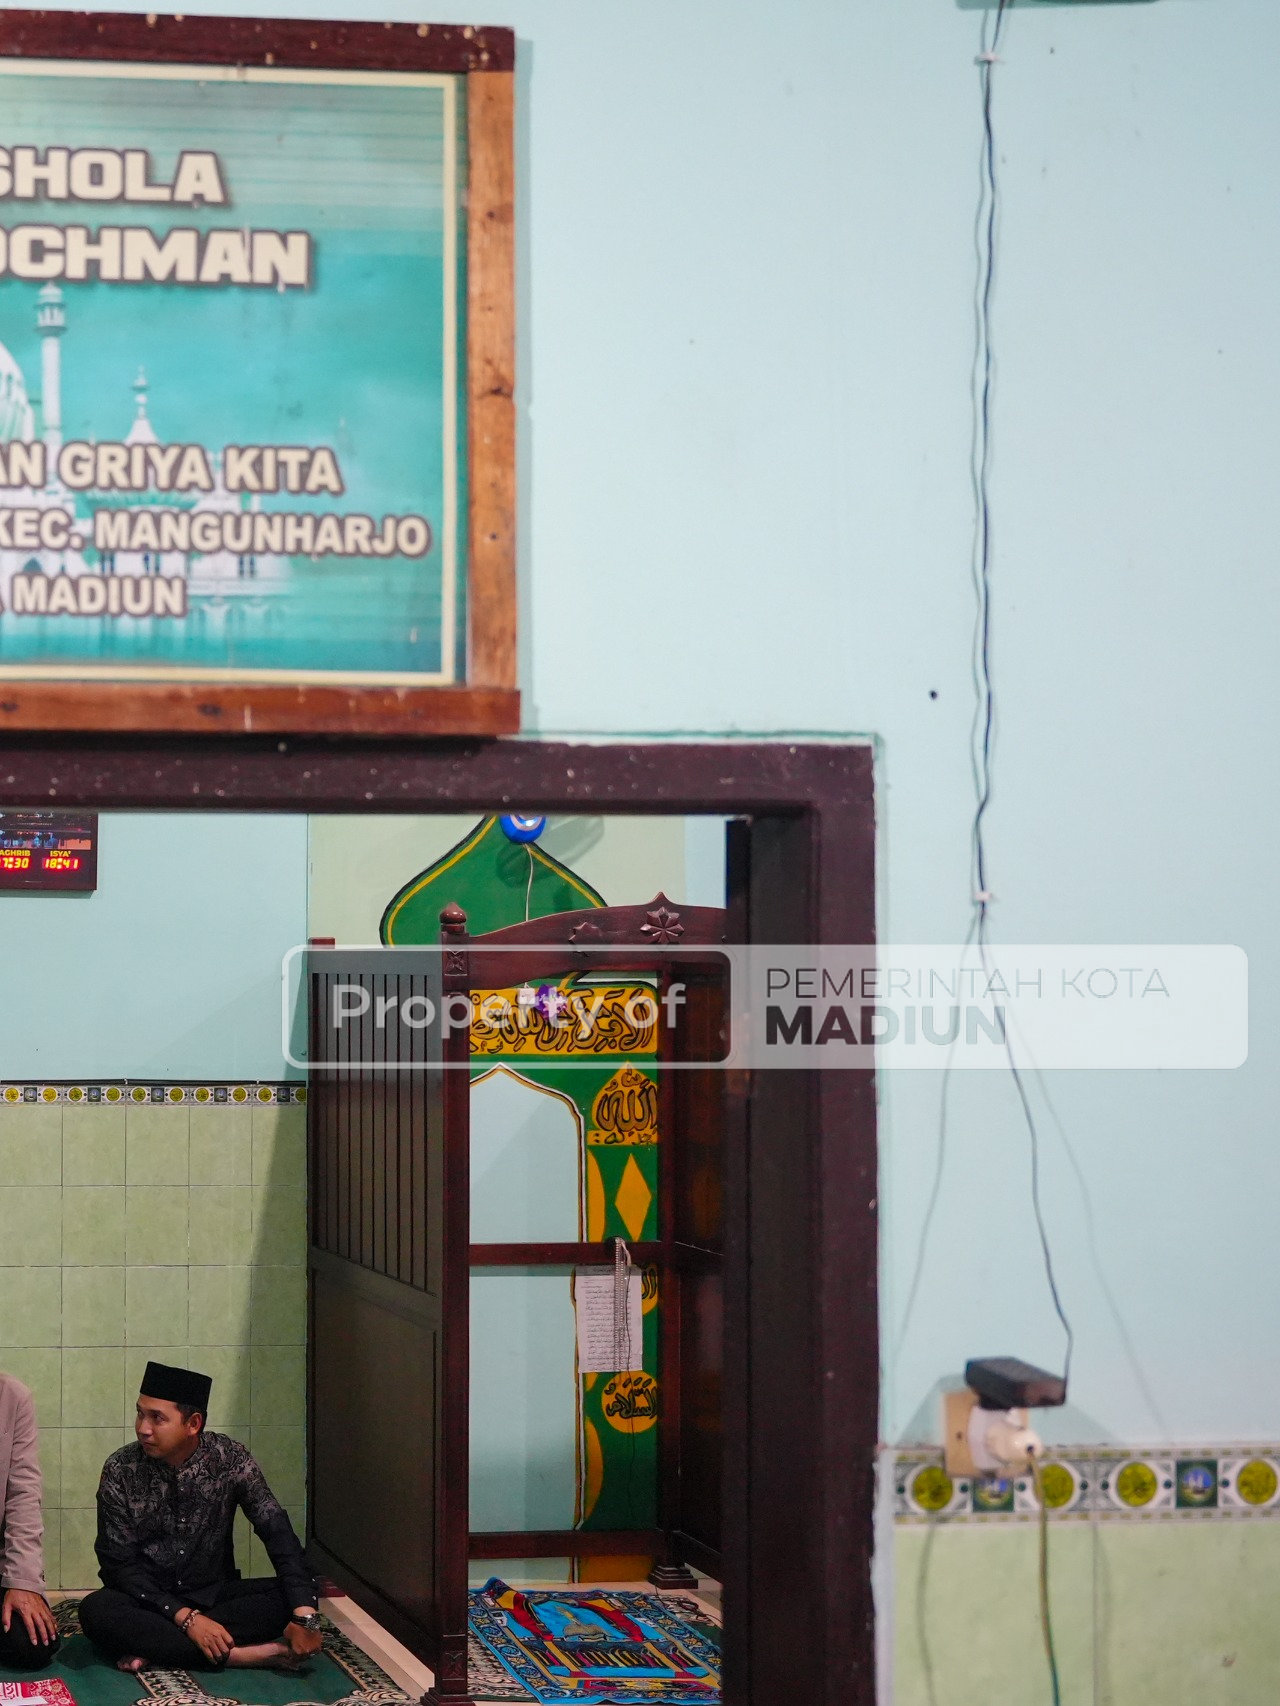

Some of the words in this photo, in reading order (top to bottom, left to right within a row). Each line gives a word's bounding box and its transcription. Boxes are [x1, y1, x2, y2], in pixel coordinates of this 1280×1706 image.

[59, 441, 214, 492] GRIYA
[223, 443, 345, 495] KITA
[94, 508, 432, 558] MANGUNHARJO
[11, 574, 187, 619] MADIUN
[45, 858, 80, 870] 18:41
